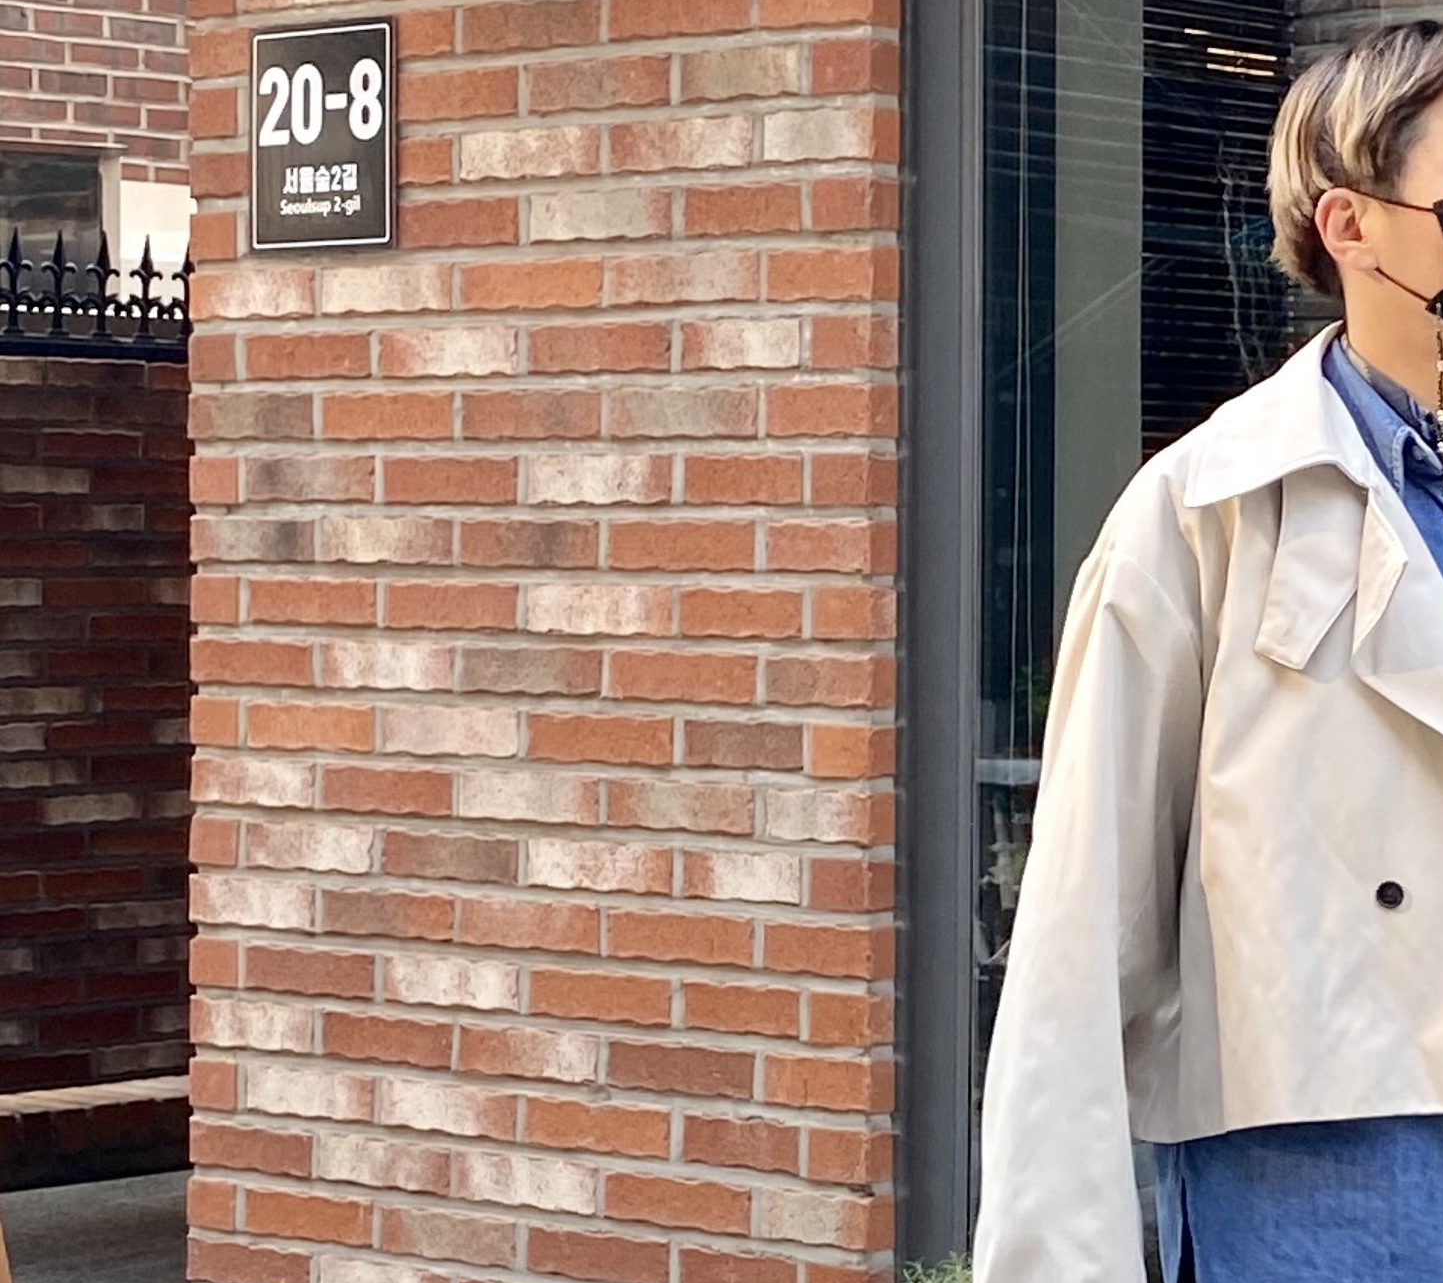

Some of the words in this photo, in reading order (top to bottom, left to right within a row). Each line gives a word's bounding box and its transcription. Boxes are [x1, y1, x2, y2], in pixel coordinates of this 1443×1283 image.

[258, 58, 383, 147] 20-8
[280, 197, 331, 217] Seoulsup
[333, 194, 361, 216] 2-gil
